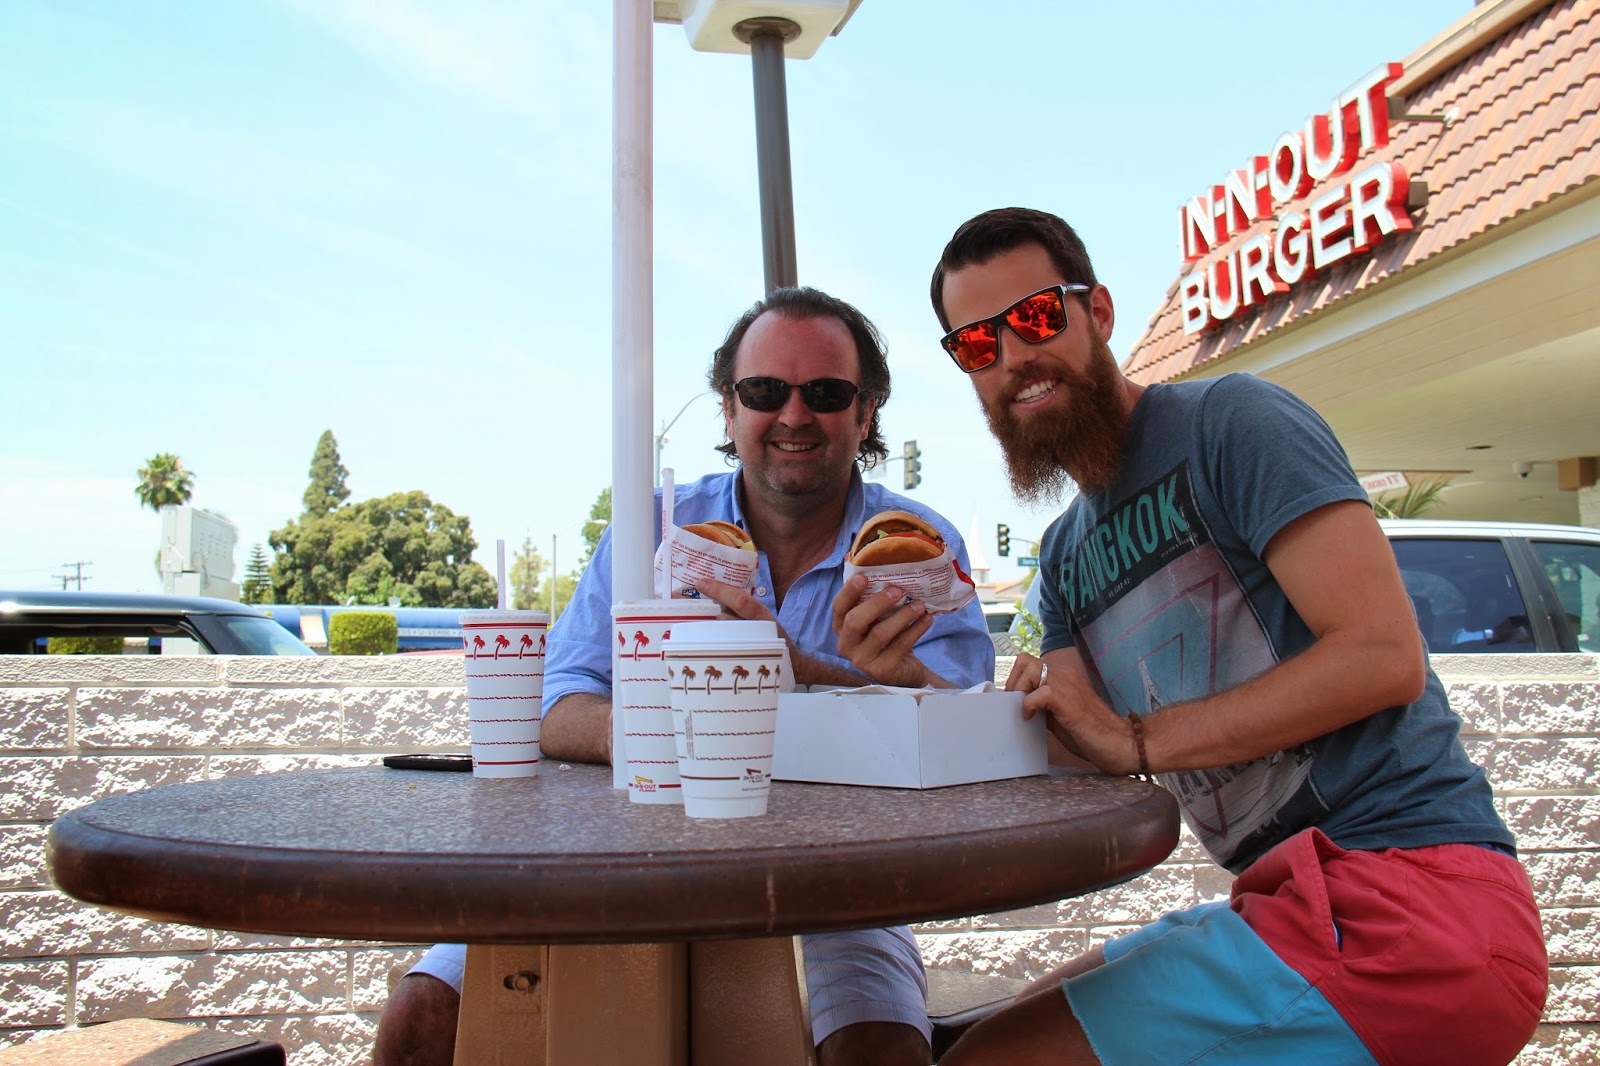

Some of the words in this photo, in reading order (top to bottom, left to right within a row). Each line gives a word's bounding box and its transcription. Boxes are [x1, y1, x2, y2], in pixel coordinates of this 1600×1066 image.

[1177, 62, 1403, 262] IN-N-OUT
[1180, 162, 1414, 336] BURGER
[1059, 473, 1190, 615] BANGKOK
